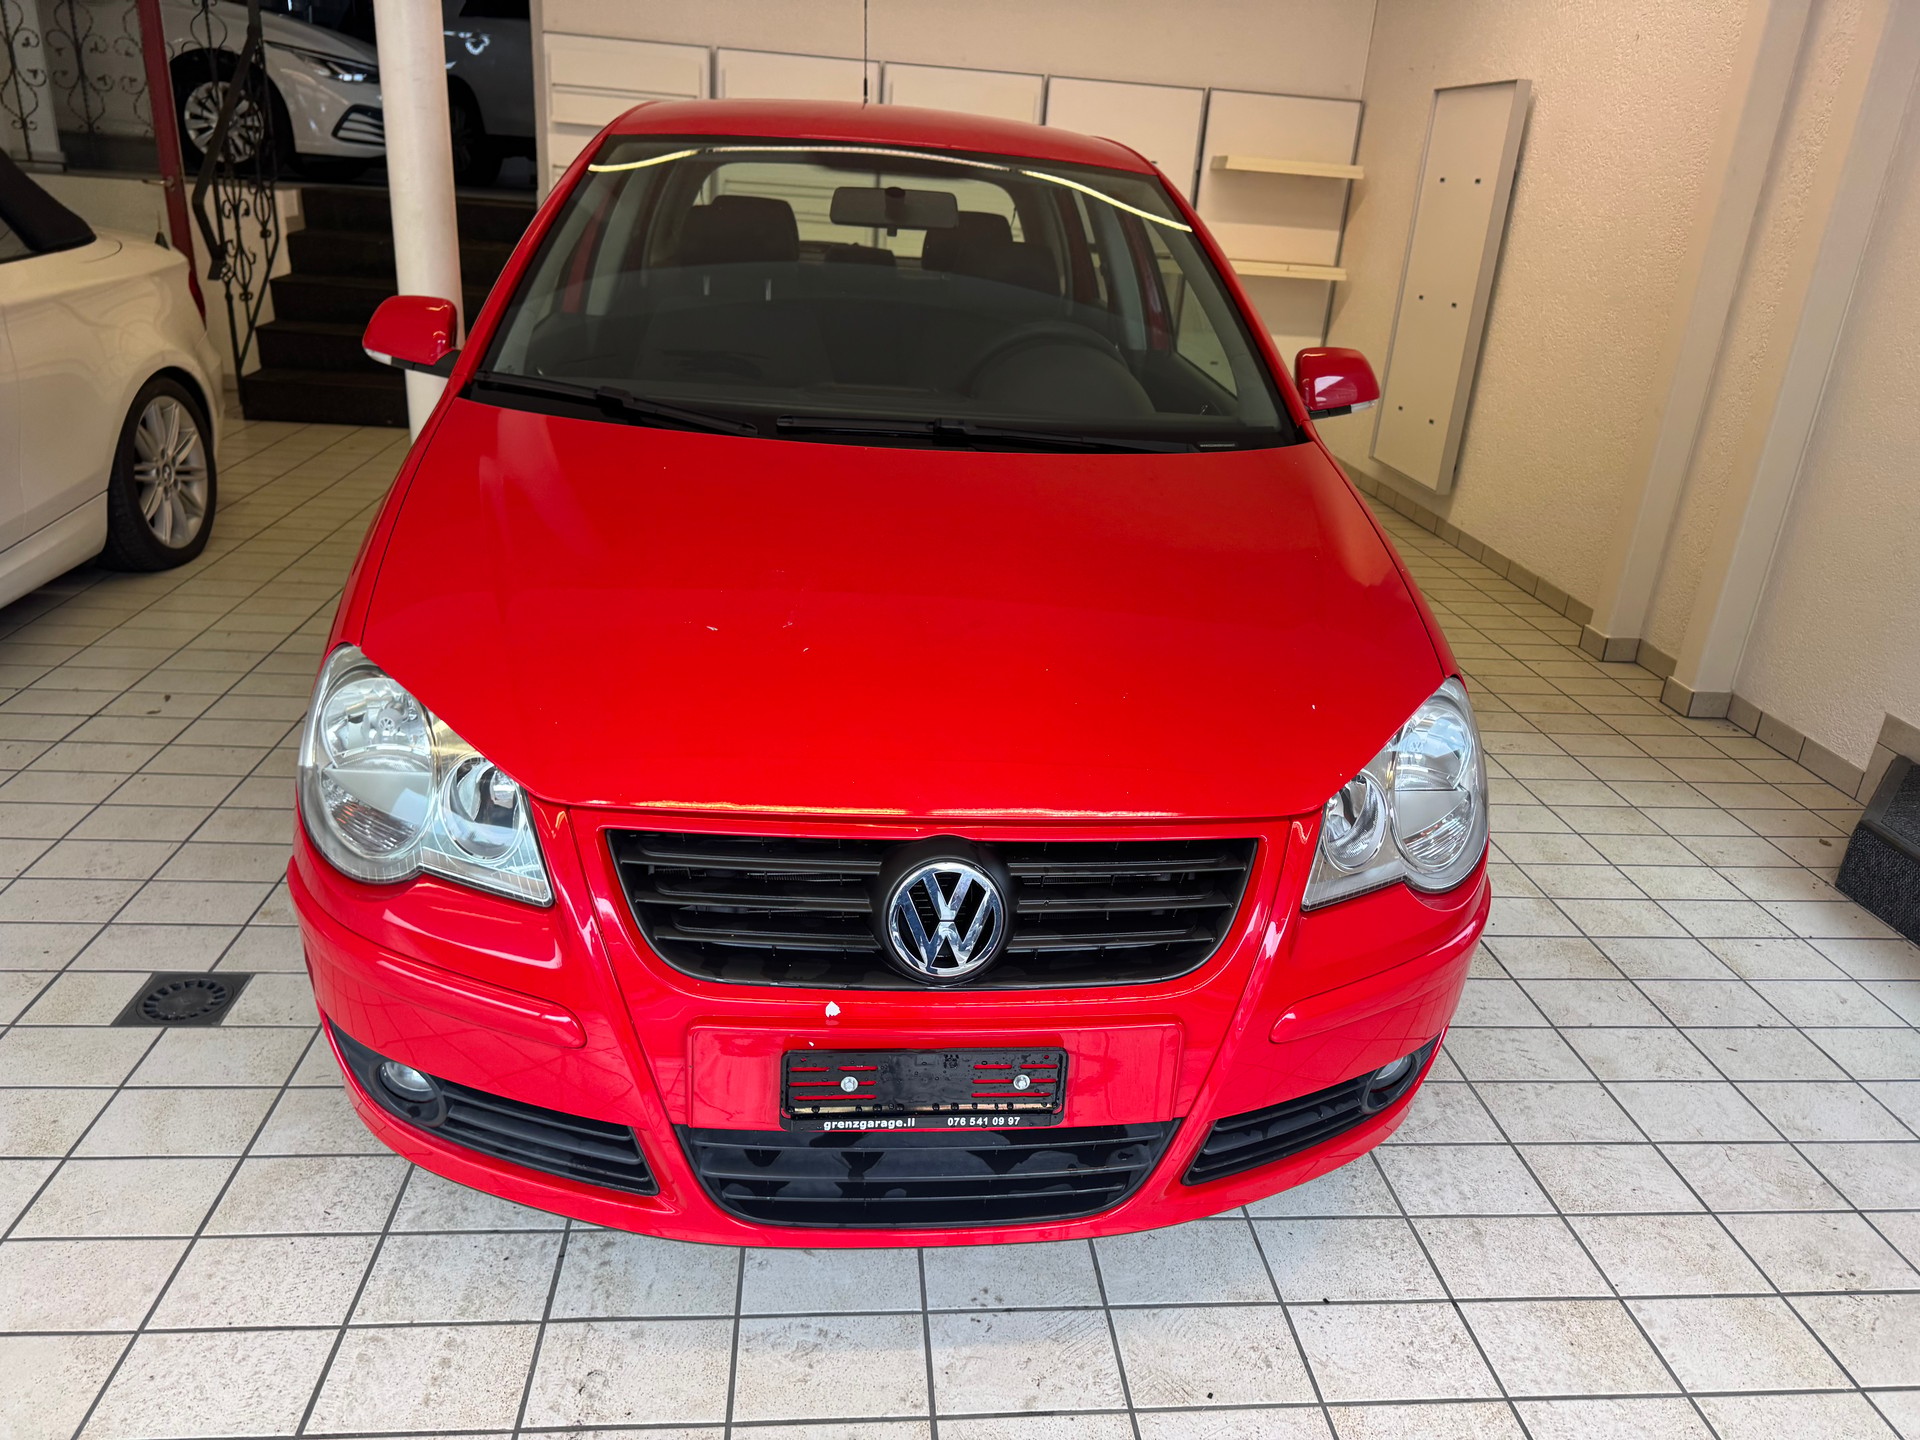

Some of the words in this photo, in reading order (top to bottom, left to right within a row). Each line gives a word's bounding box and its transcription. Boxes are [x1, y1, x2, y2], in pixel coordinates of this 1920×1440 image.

[889, 863, 1003, 976] VW
[947, 1117, 966, 1126] 076
[969, 1117, 988, 1126] 541
[992, 1116, 1005, 1125] 09
[1007, 1116, 1020, 1125] 97
